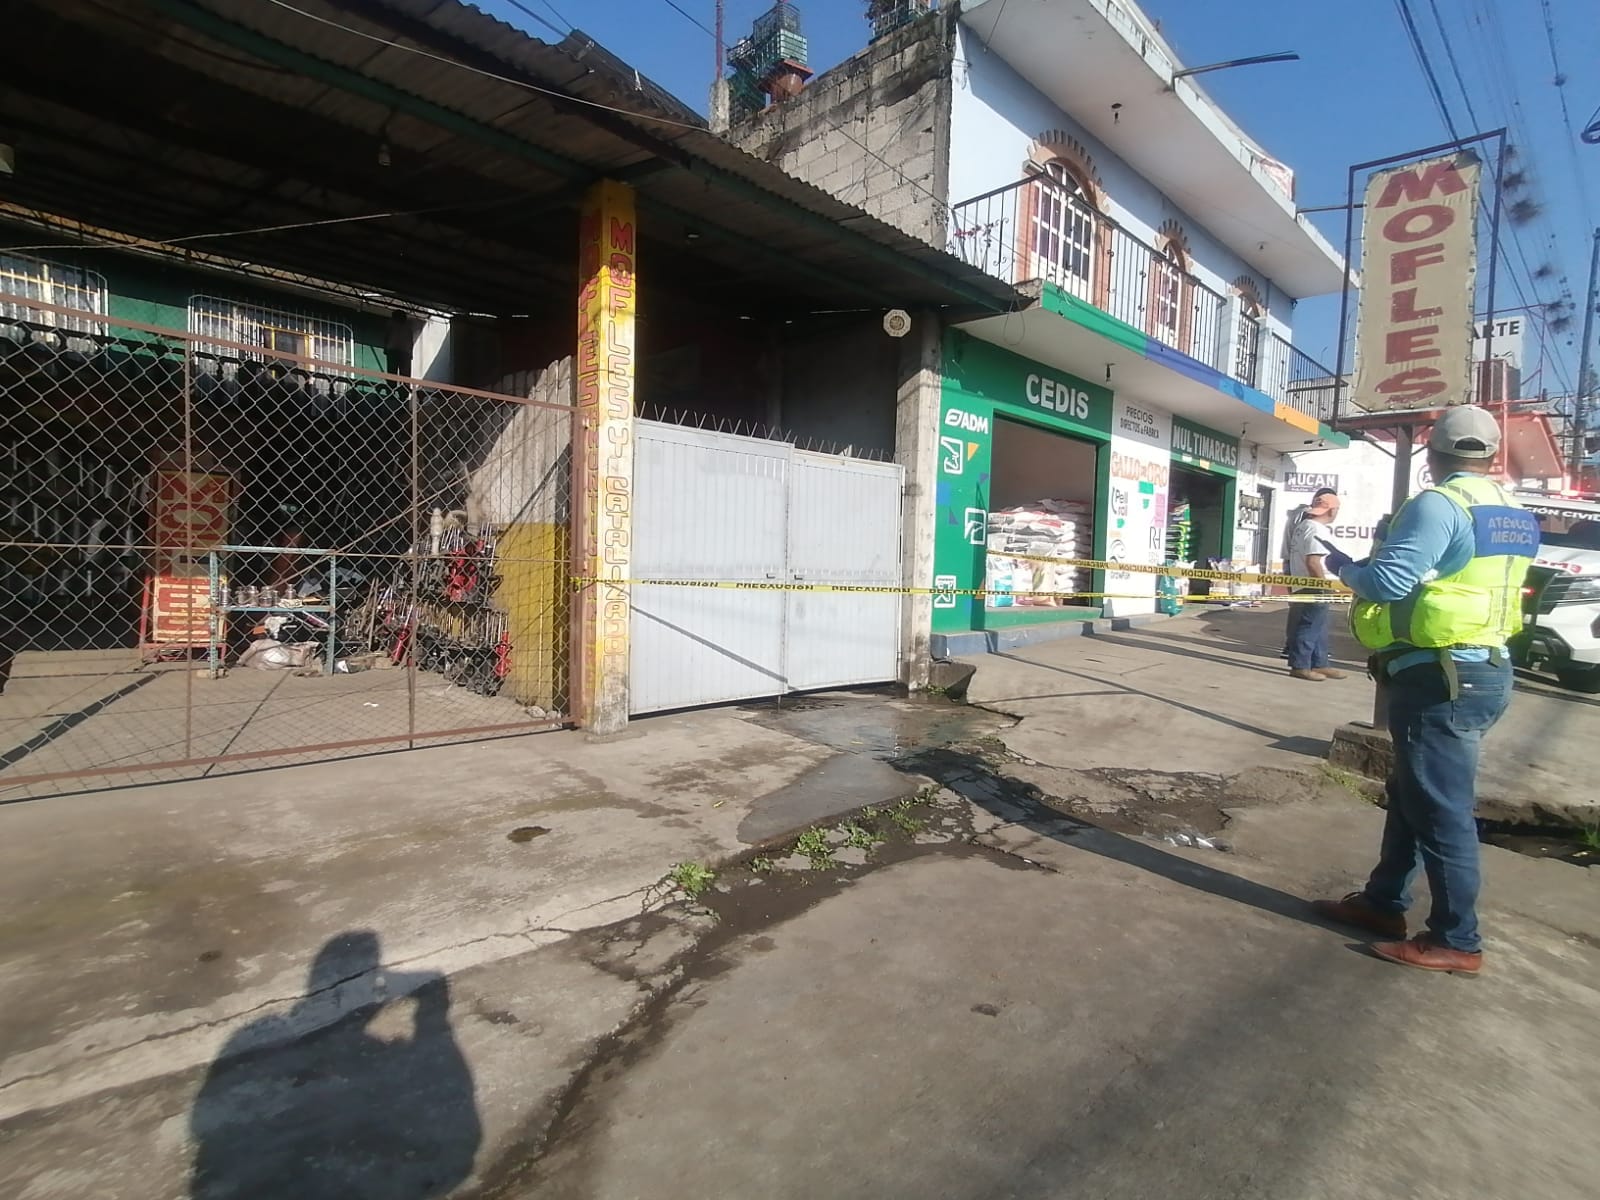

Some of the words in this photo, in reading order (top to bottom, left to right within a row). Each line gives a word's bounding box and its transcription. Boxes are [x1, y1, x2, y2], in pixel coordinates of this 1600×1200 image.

[1374, 158, 1468, 404] MOFLES
[609, 216, 634, 421] MOFLES
[1026, 373, 1089, 420] CEDIS
[960, 412, 989, 435] ADM
[1126, 405, 1154, 425] PRECIOS
[1111, 450, 1140, 481] GALLO
[1287, 473, 1337, 487] NUCAN
[1491, 530, 1533, 545] MEDICA
